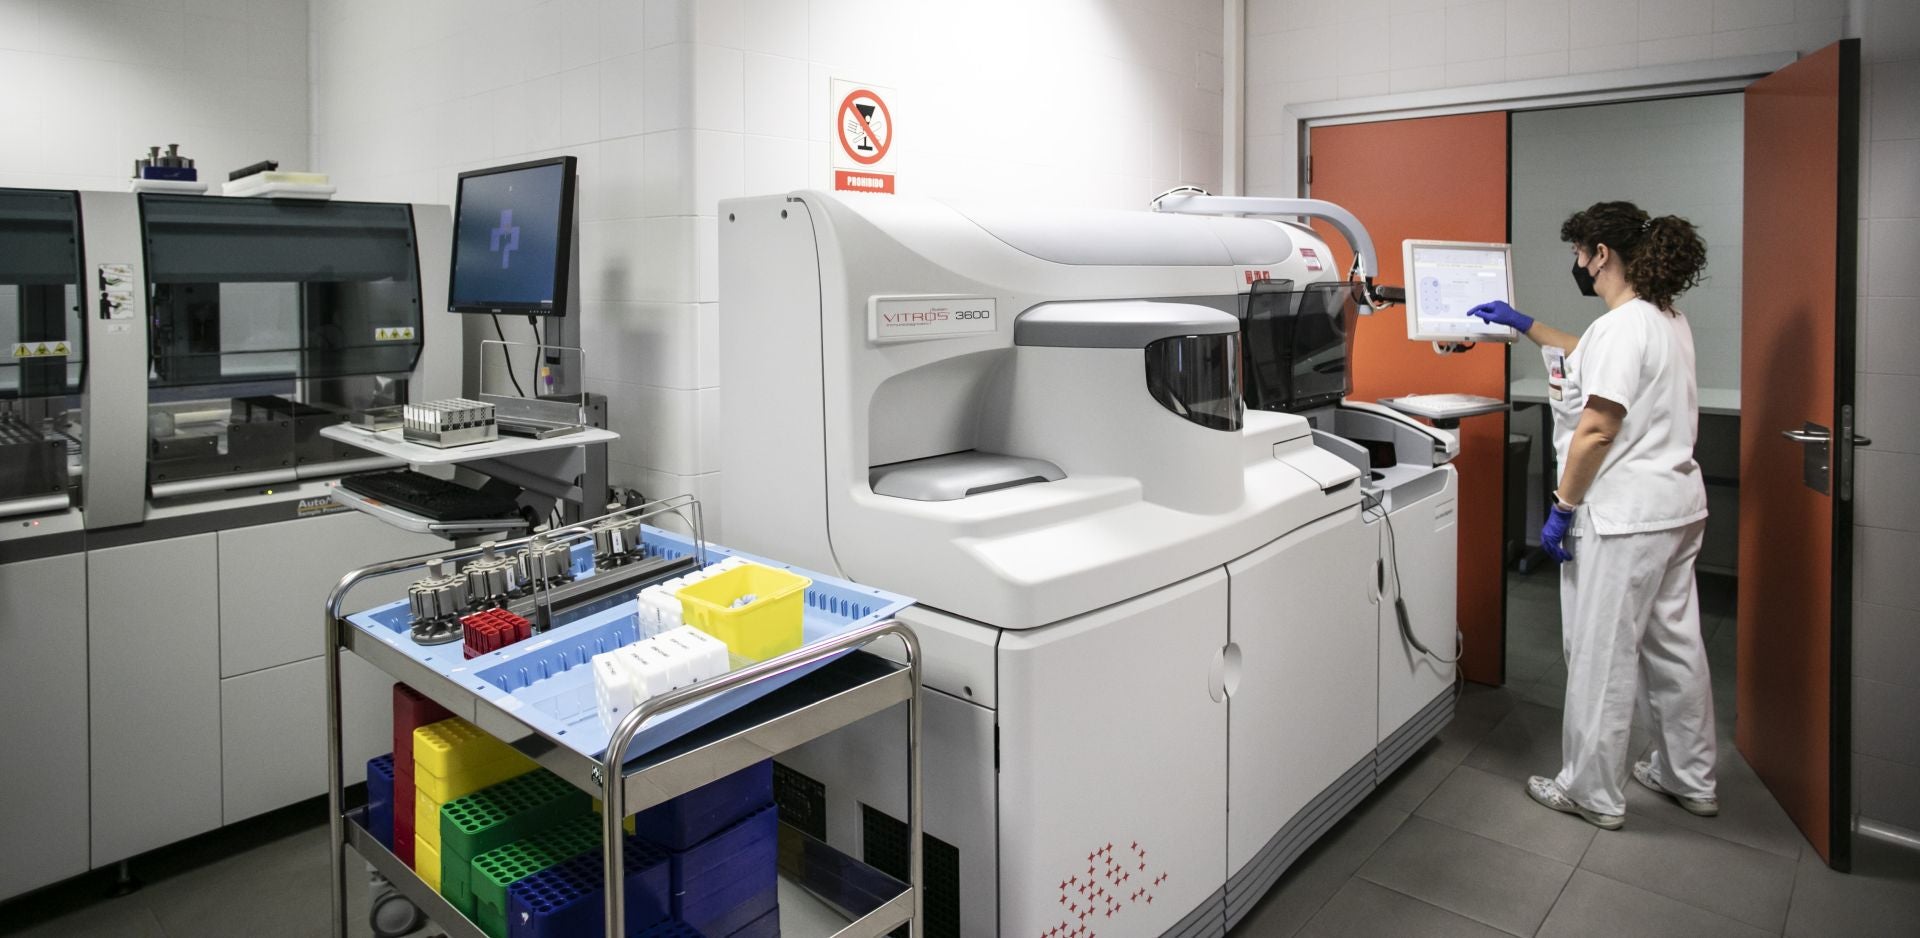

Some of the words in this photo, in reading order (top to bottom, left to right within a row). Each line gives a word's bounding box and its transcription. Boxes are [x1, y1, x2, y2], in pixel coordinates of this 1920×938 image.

[847, 175, 884, 189] PROHIBIDO
[883, 311, 950, 323] VITROS
[955, 310, 990, 320] 3600
